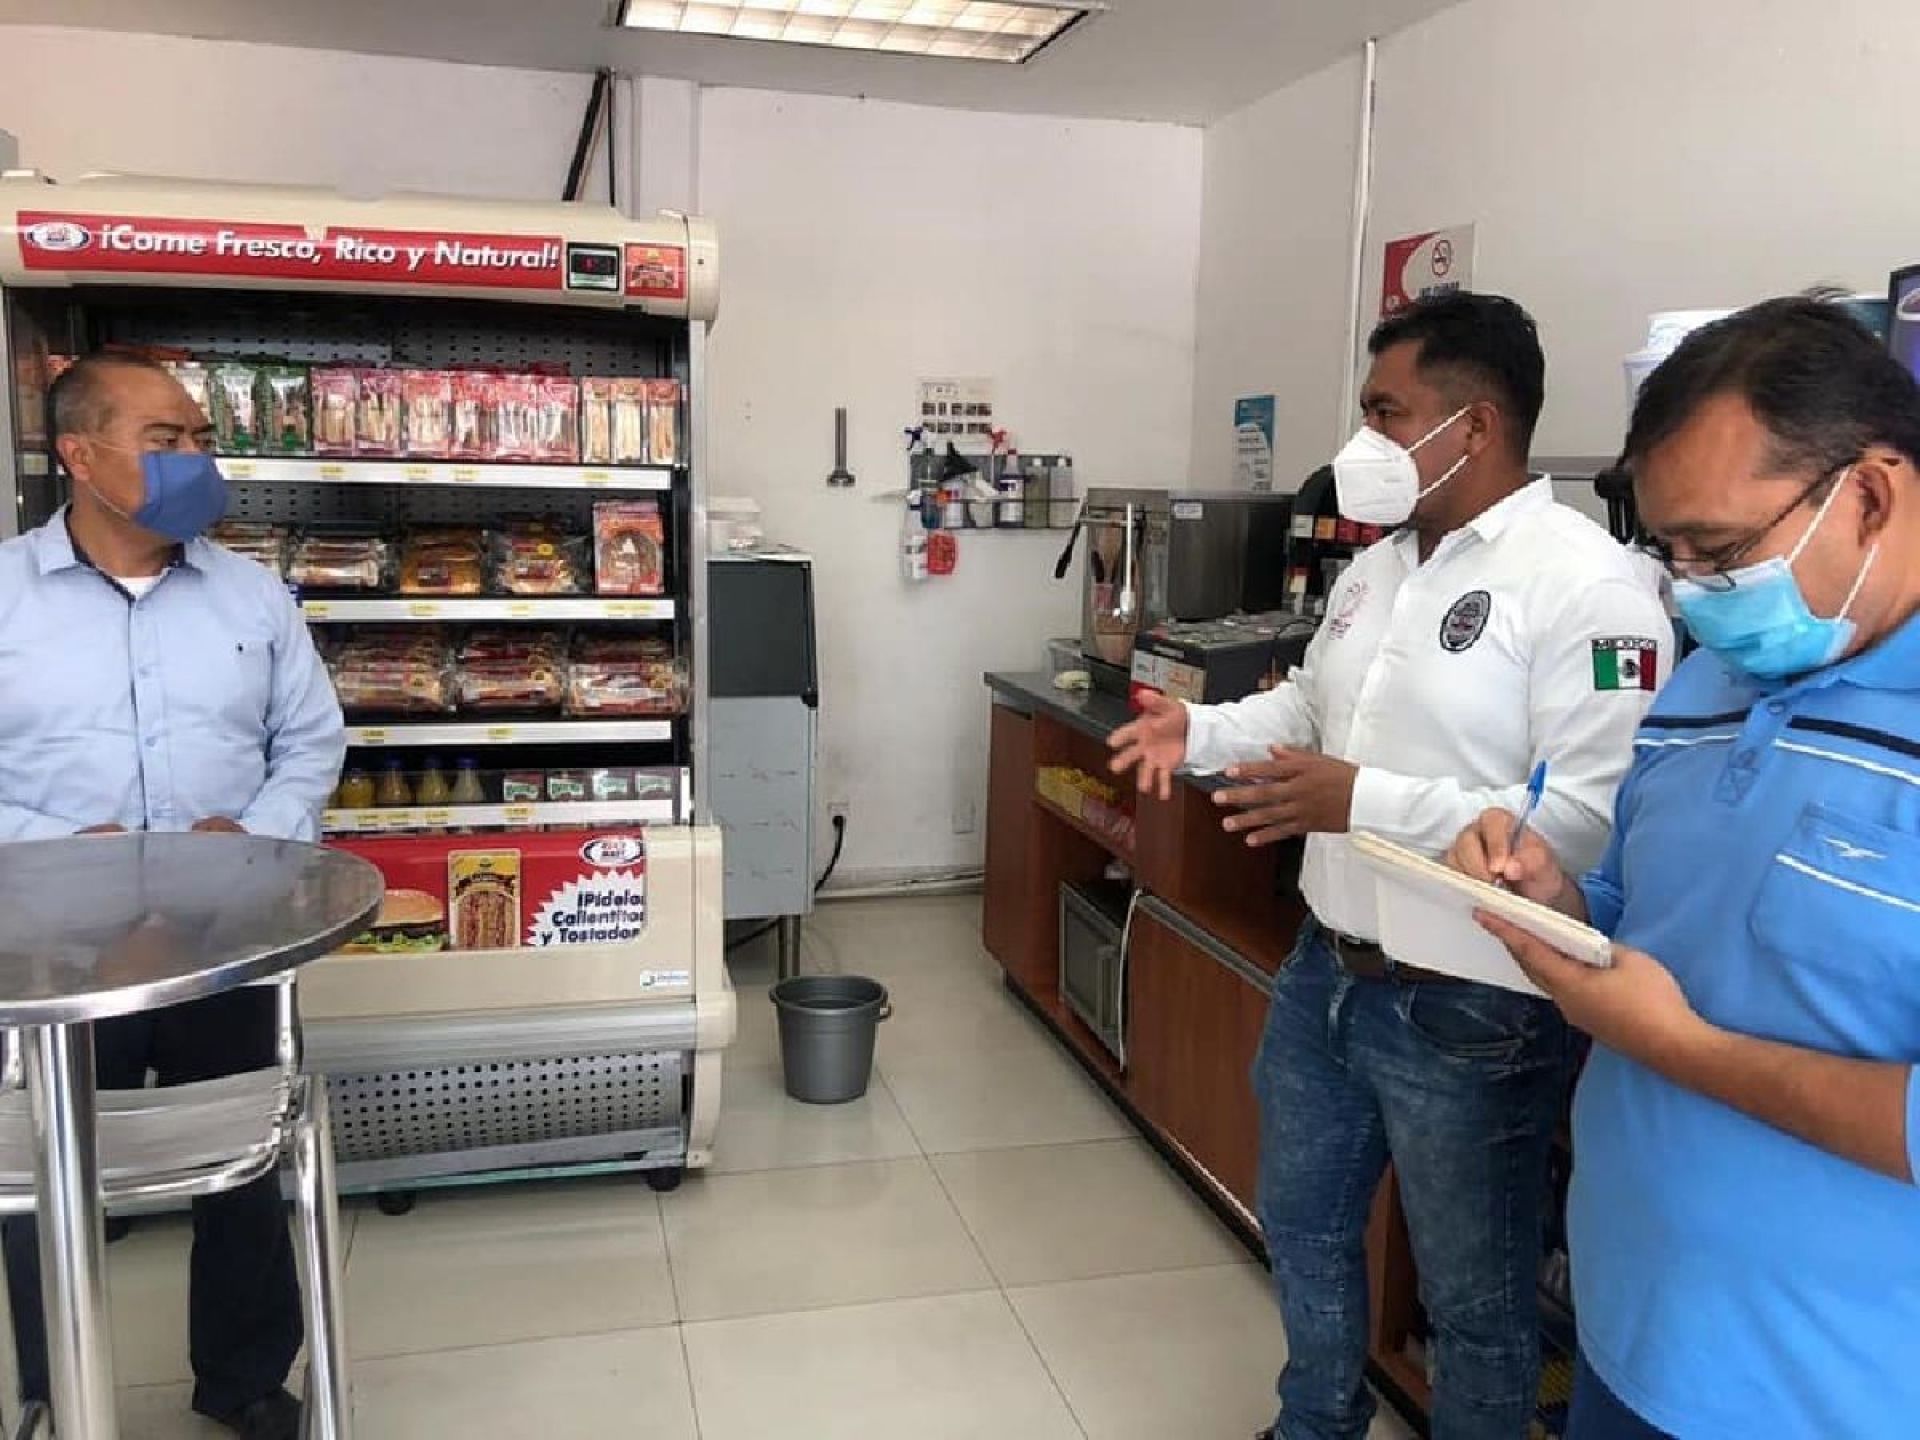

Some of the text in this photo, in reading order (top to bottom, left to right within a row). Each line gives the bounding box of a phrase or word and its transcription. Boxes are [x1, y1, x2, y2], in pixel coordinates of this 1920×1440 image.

[216, 229, 321, 264] Fresco,
[335, 237, 396, 263] Rico
[407, 247, 425, 272] y
[434, 241, 560, 268] Natural!
[541, 931, 553, 945] y
